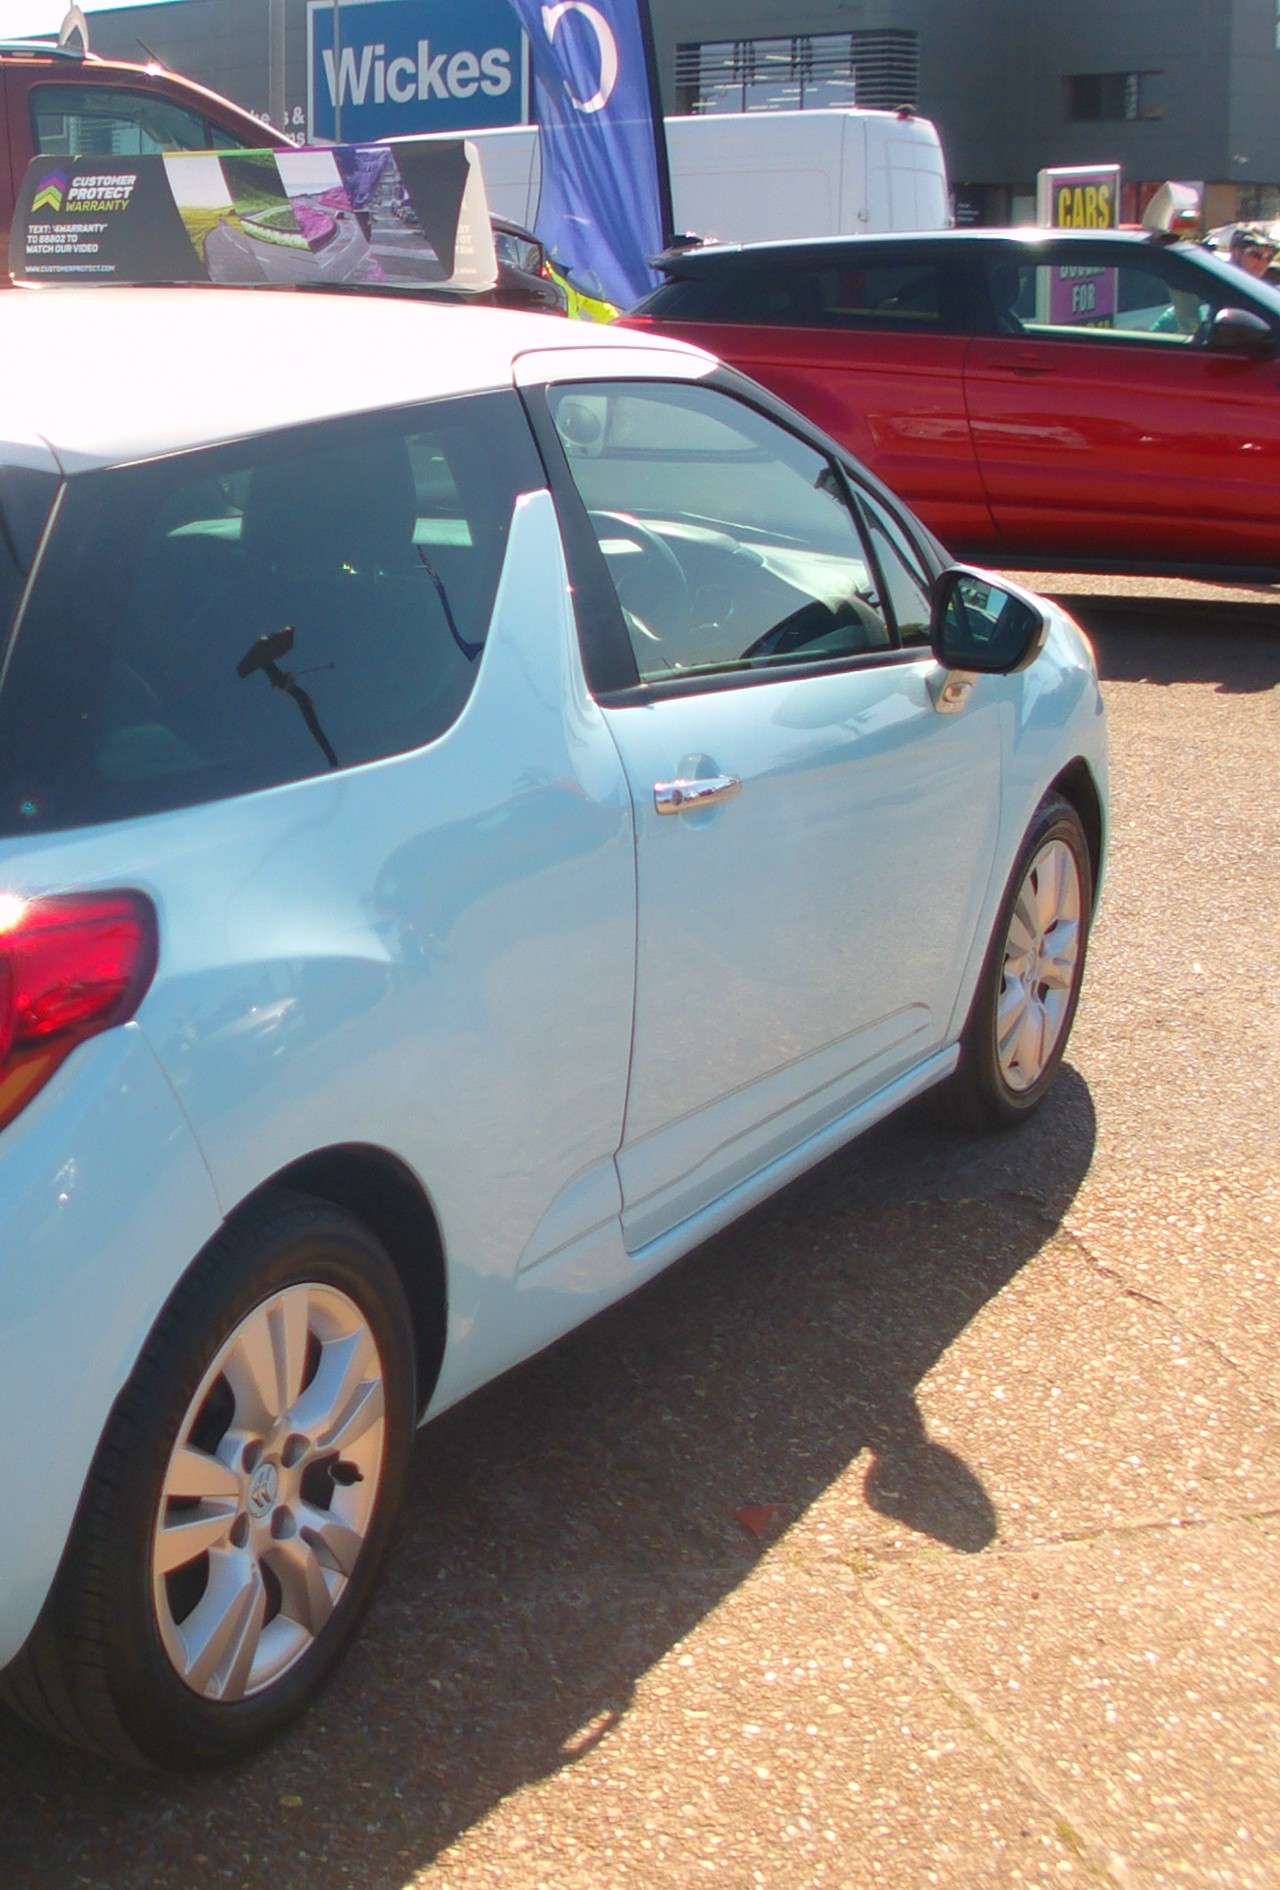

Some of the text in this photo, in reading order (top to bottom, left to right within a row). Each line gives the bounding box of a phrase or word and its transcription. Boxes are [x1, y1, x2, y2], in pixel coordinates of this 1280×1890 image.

[322, 40, 512, 107] Wickes
[72, 175, 137, 187] CUSTOMER
[67, 187, 133, 200] PROTECT
[65, 200, 129, 212] WARRANTY
[1058, 185, 1111, 229] CARS
[27, 235, 37, 244] TO
[66, 233, 78, 243] TO
[26, 243, 99, 254] WATCH OUR VIDEO
[1072, 283, 1096, 312] FOR
